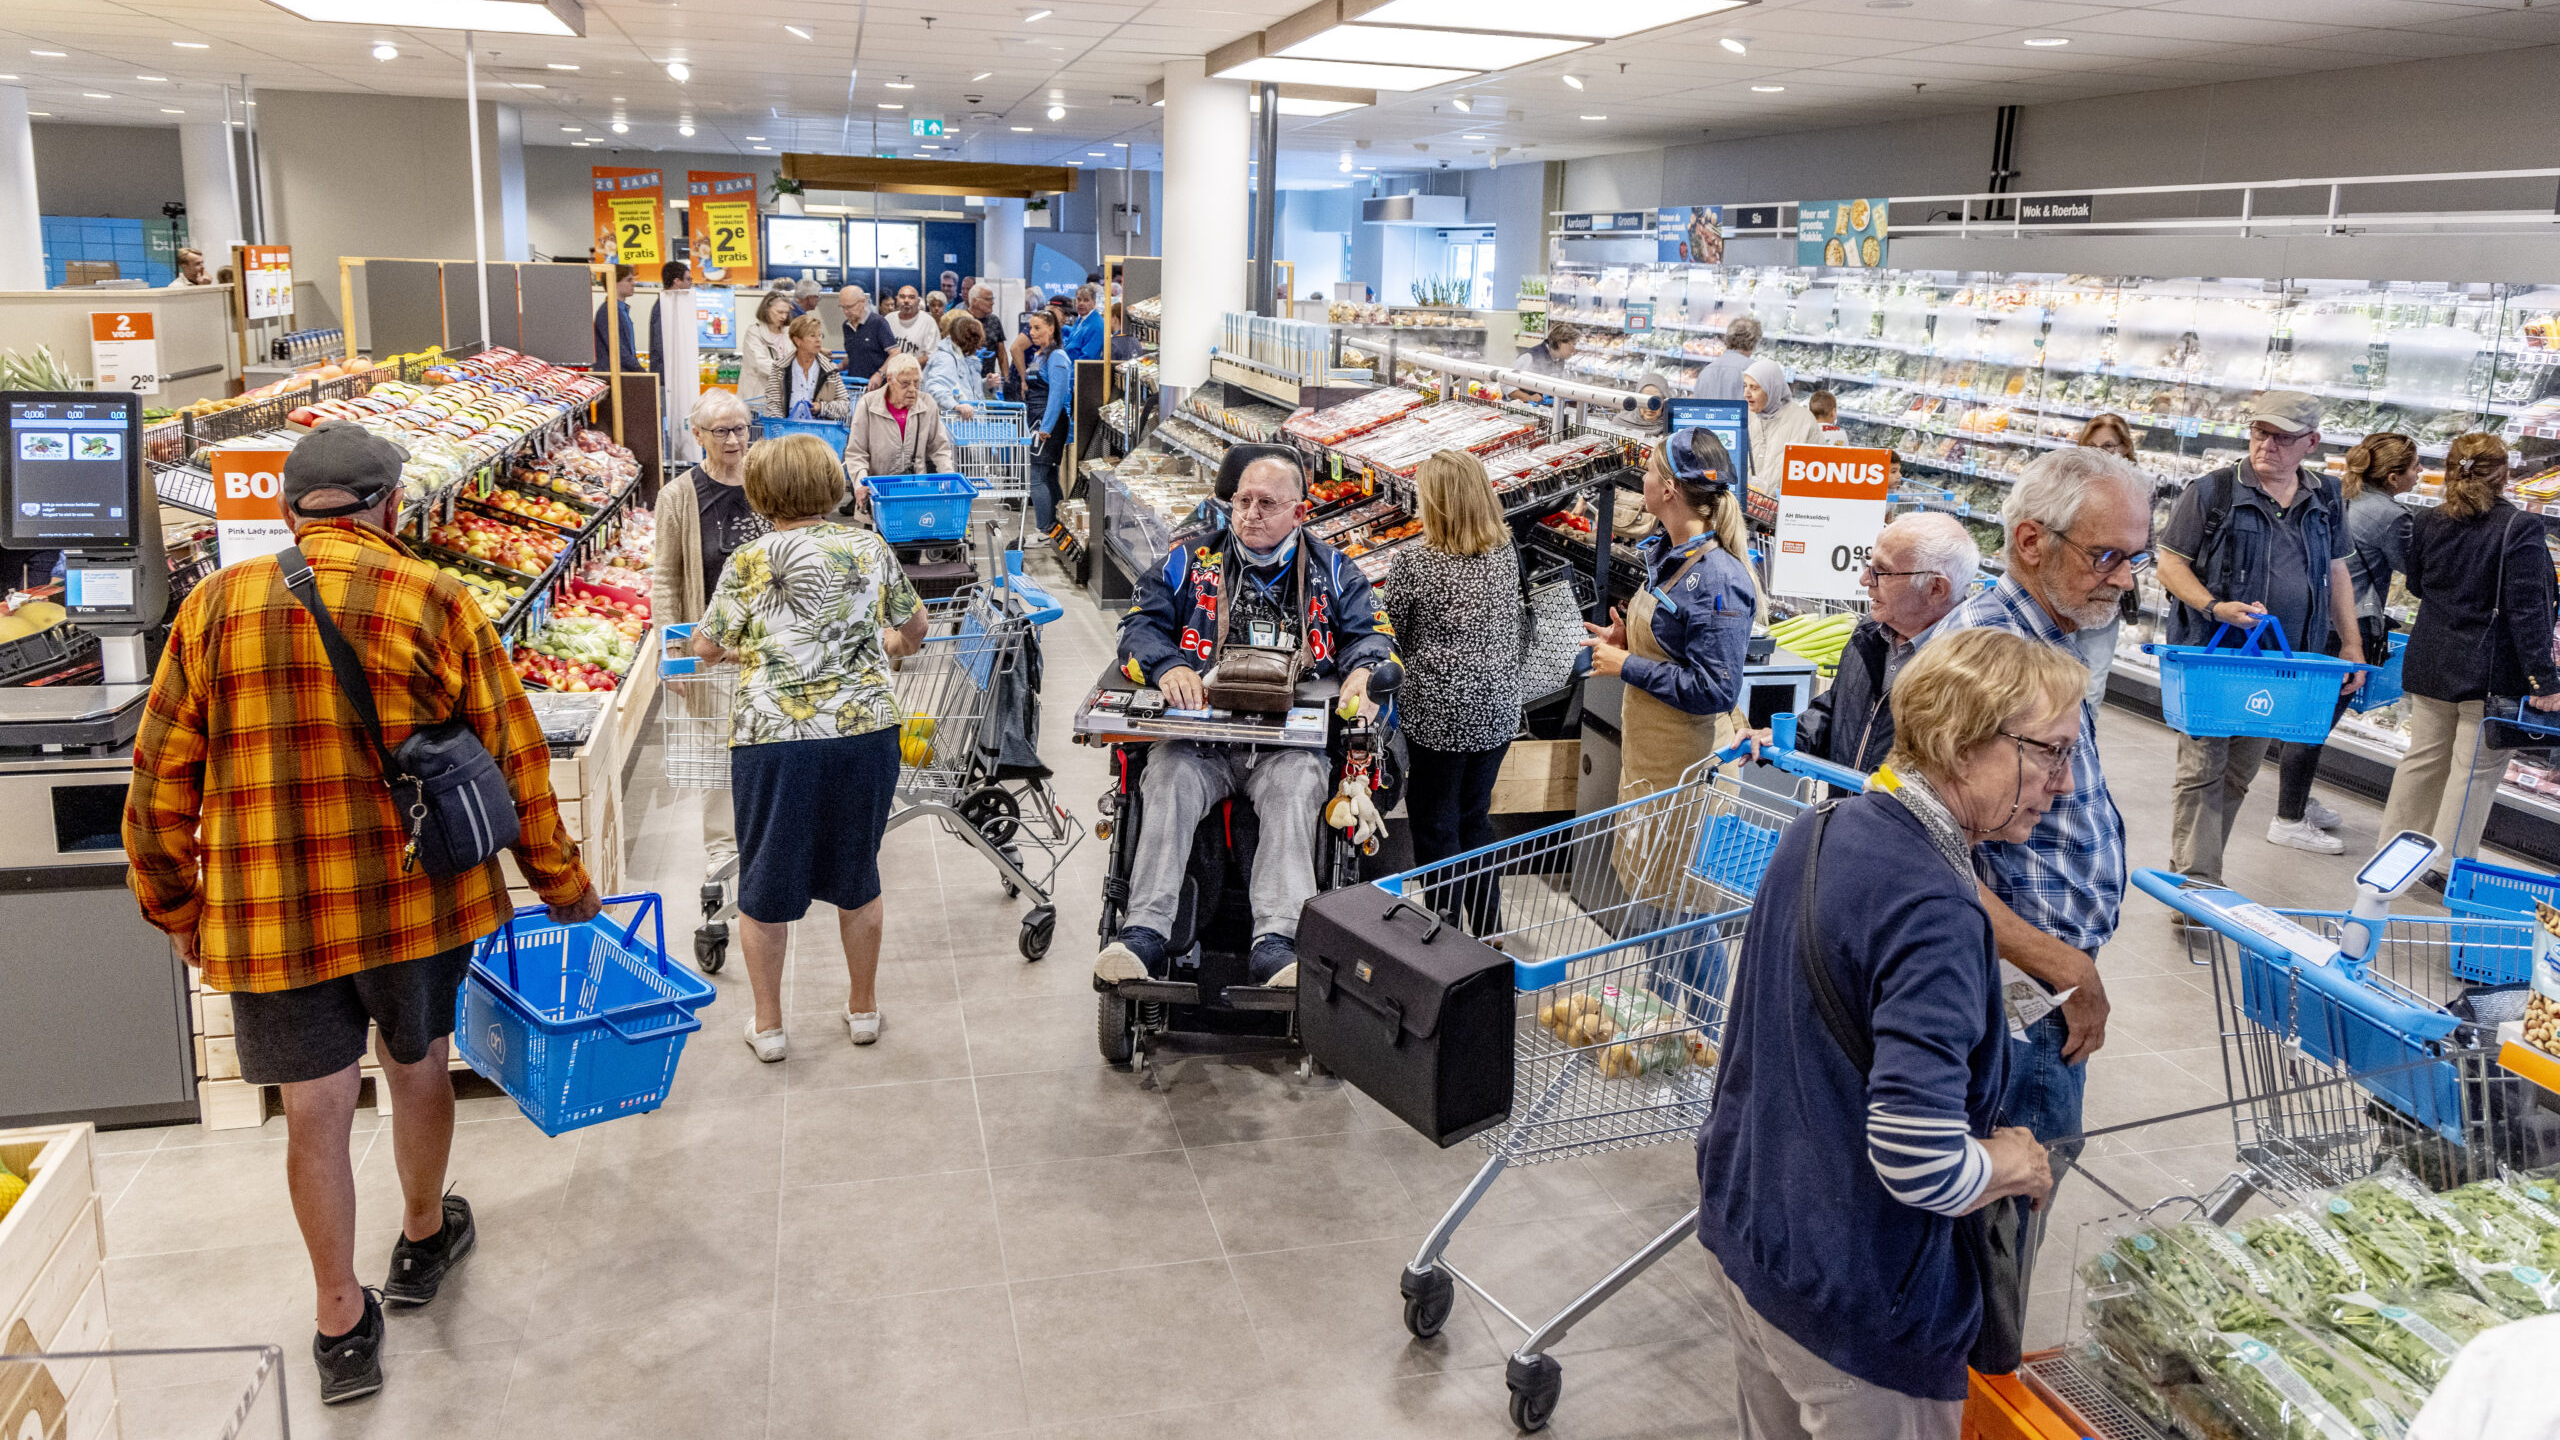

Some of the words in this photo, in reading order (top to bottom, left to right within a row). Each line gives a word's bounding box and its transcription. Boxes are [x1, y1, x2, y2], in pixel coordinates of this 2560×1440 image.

[622, 174, 658, 188] JAAR
[716, 179, 752, 192] JAAR
[1816, 210, 1829, 219] met
[2022, 204, 2042, 218] Wok
[2042, 204, 2050, 217] &
[2052, 203, 2089, 216] Roerbak
[1567, 216, 1591, 230] Aardappel
[1618, 216, 1638, 227] Groente
[1752, 212, 1762, 224] Sla
[624, 250, 654, 260] gratis
[718, 252, 748, 263] gratis
[116, 315, 131, 331] 2
[66, 411, 83, 420] 0,00
[110, 411, 126, 420] 0,00
[1788, 460, 1884, 485] BONUS
[1794, 514, 1830, 522] Bleekselderij
[248, 528, 266, 536] Lady
